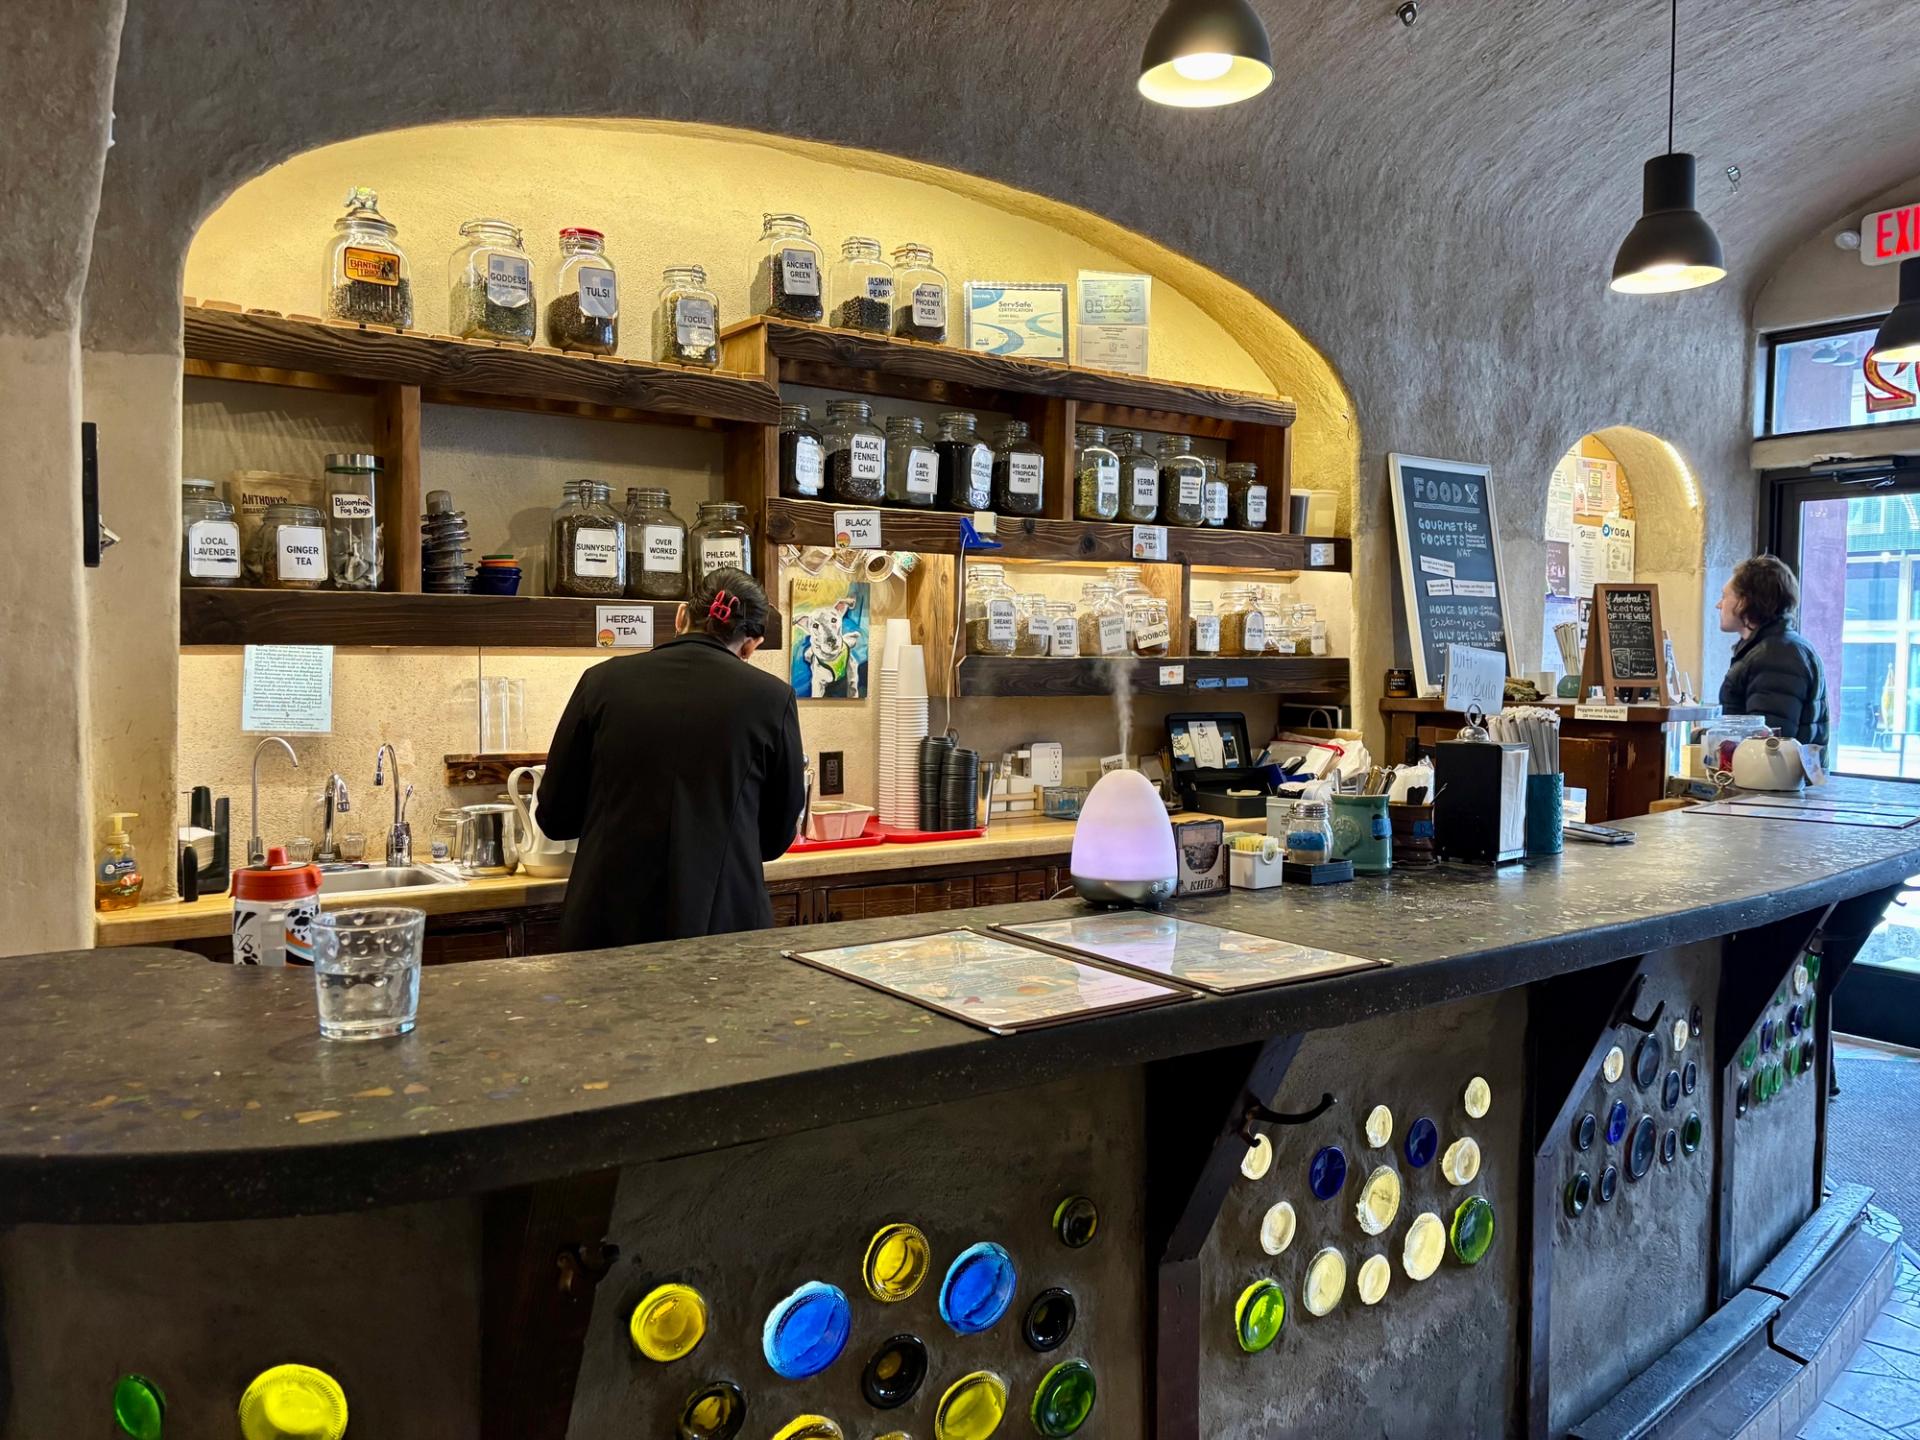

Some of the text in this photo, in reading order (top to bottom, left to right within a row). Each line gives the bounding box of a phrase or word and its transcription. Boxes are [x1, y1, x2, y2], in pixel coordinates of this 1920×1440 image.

[1876, 206, 1920, 258] EXI
[786, 261, 813, 270] ANCIENT
[490, 272, 527, 285] GODDESS
[790, 271, 811, 279] GREEN
[868, 276, 893, 287] JASMIN
[585, 286, 610, 298] TULSI
[915, 290, 940, 299] ANCIENT
[915, 299, 941, 308] PHOENIX
[920, 308, 936, 316] PUER
[683, 315, 707, 324] FOCUS
[855, 440, 879, 450] BLACK
[854, 452, 880, 462] FENNEL
[858, 464, 876, 473] CHAI
[916, 462, 929, 470] EARL
[1136, 478, 1155, 486] YERBA
[1138, 488, 1153, 496] MATE
[1413, 476, 1463, 504] FOOD
[340, 506, 371, 515] Fog Bags
[845, 518, 872, 527] BLACK
[1418, 517, 1463, 532] GOURMET
[850, 529, 868, 538] TEA
[1138, 532, 1157, 540] GREE
[1610, 527, 1631, 538] YOGA
[200, 536, 229, 546] LOCAL
[655, 538, 672, 546] OVER
[1420, 532, 1465, 547] POCKETS
[193, 547, 236, 557] LAVENDER
[286, 545, 319, 555] GINGER
[576, 543, 617, 552] SUNNYSIDE
[649, 547, 677, 555] WORKED
[295, 557, 312, 566] TEA
[704, 560, 716, 568] NO
[1429, 605, 1455, 615] HOUSE
[1457, 605, 1479, 615] SOUP
[606, 614, 647, 624] HERBAL
[1618, 612, 1633, 620] THE
[1633, 613, 1651, 621] WEEK
[616, 627, 637, 636] TEA
[1137, 630, 1168, 642] ROOIBOS
[1433, 630, 1488, 641] DAILY SPECIAL
